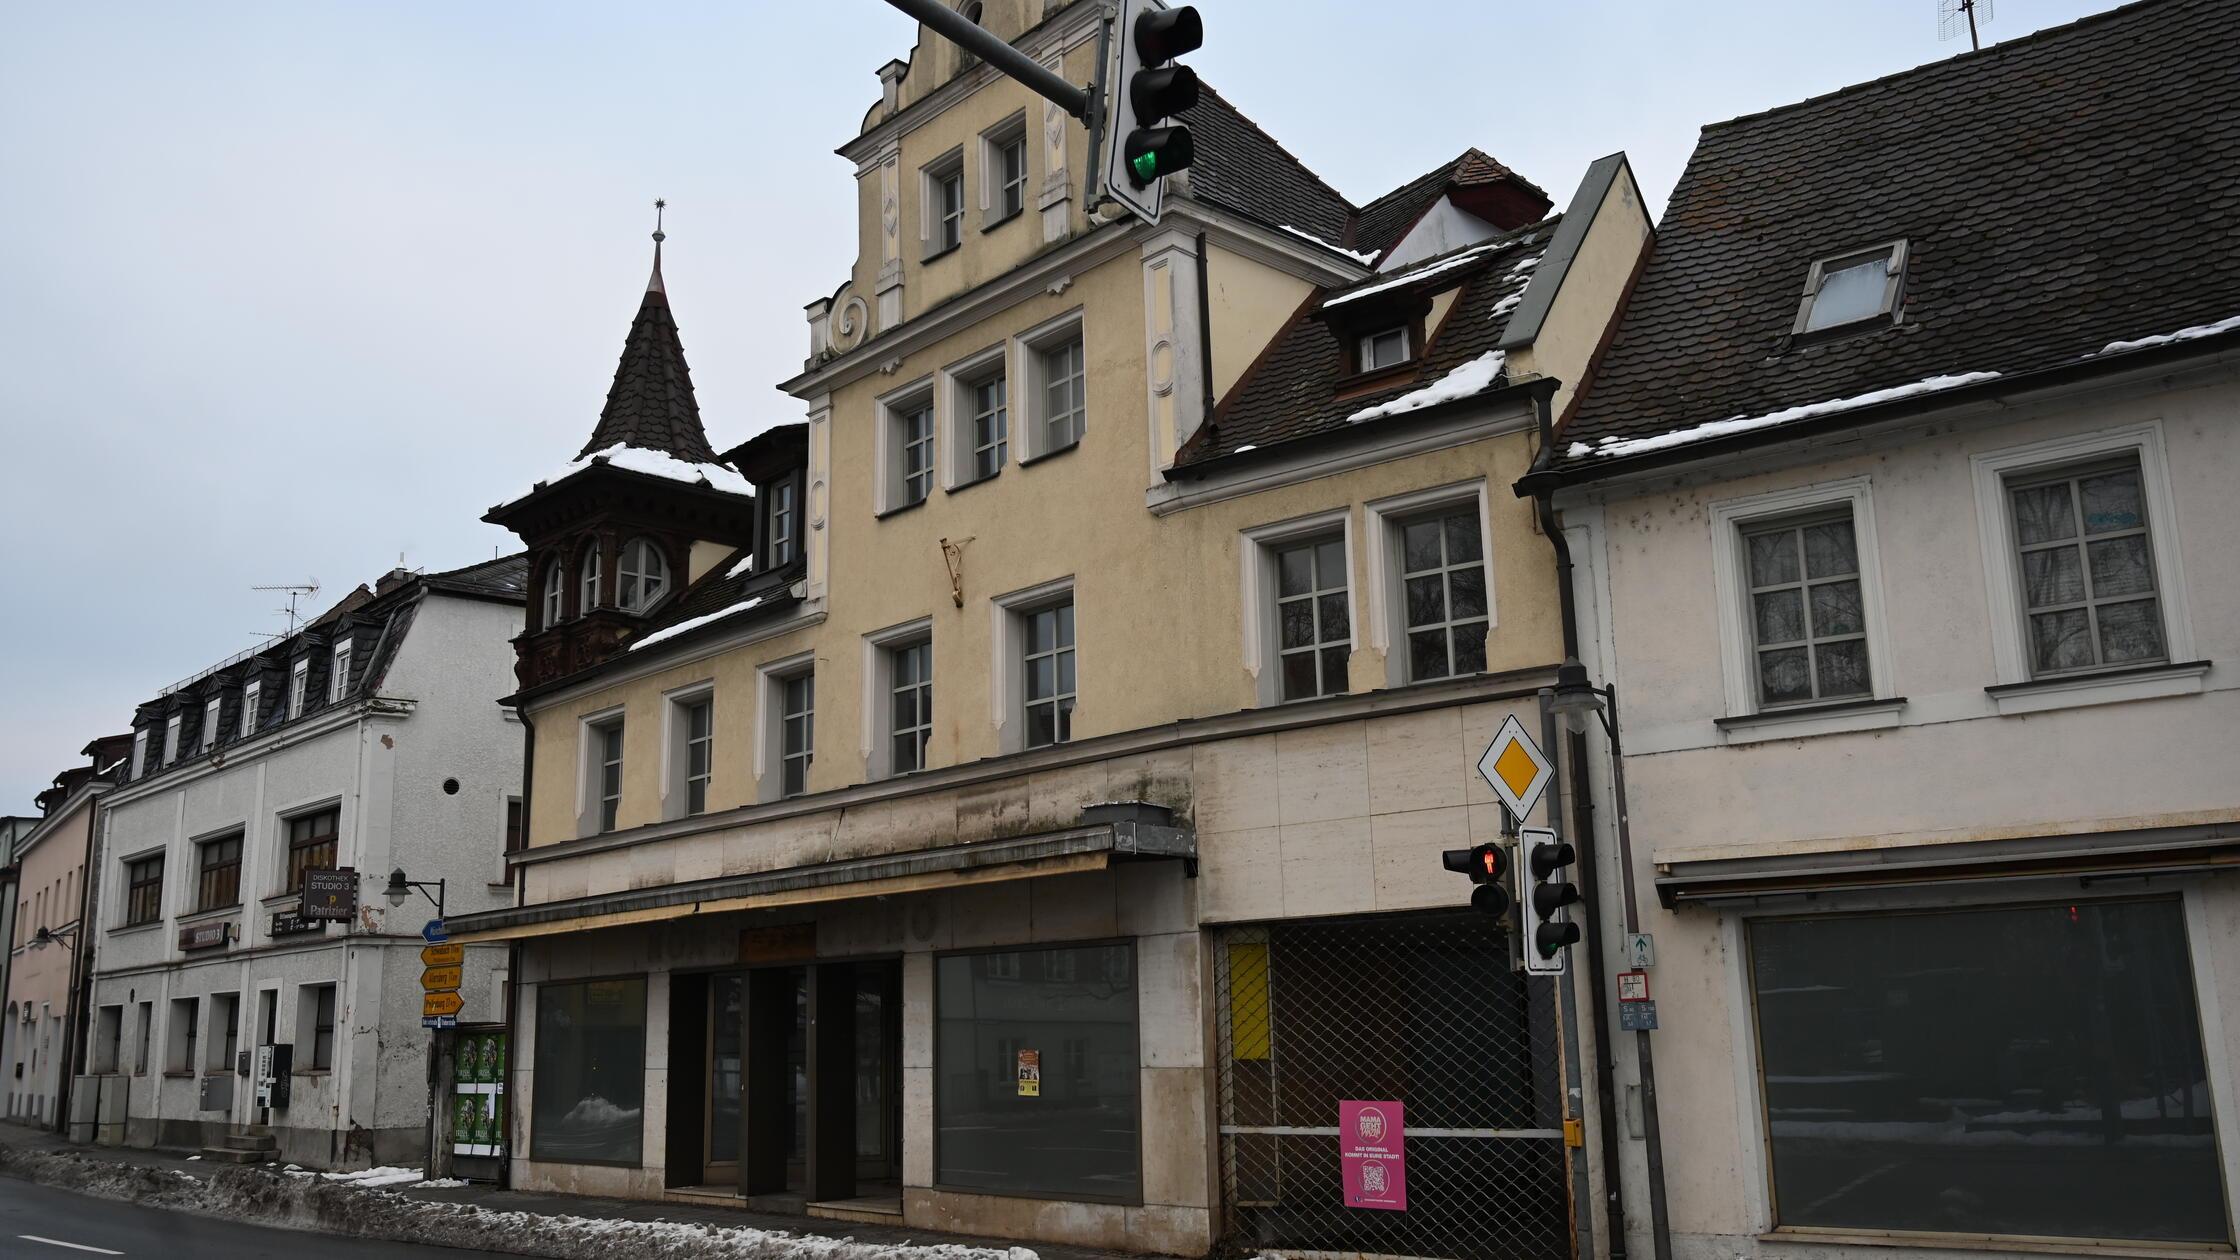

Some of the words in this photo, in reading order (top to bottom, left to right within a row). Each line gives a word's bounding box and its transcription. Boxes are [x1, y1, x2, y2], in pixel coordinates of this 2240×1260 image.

[311, 882, 342, 890] STUDIO
[344, 882, 350, 890] 3
[310, 904, 348, 916] Patrizier
[195, 929, 216, 943] STUDIO
[216, 928, 220, 940] 3
